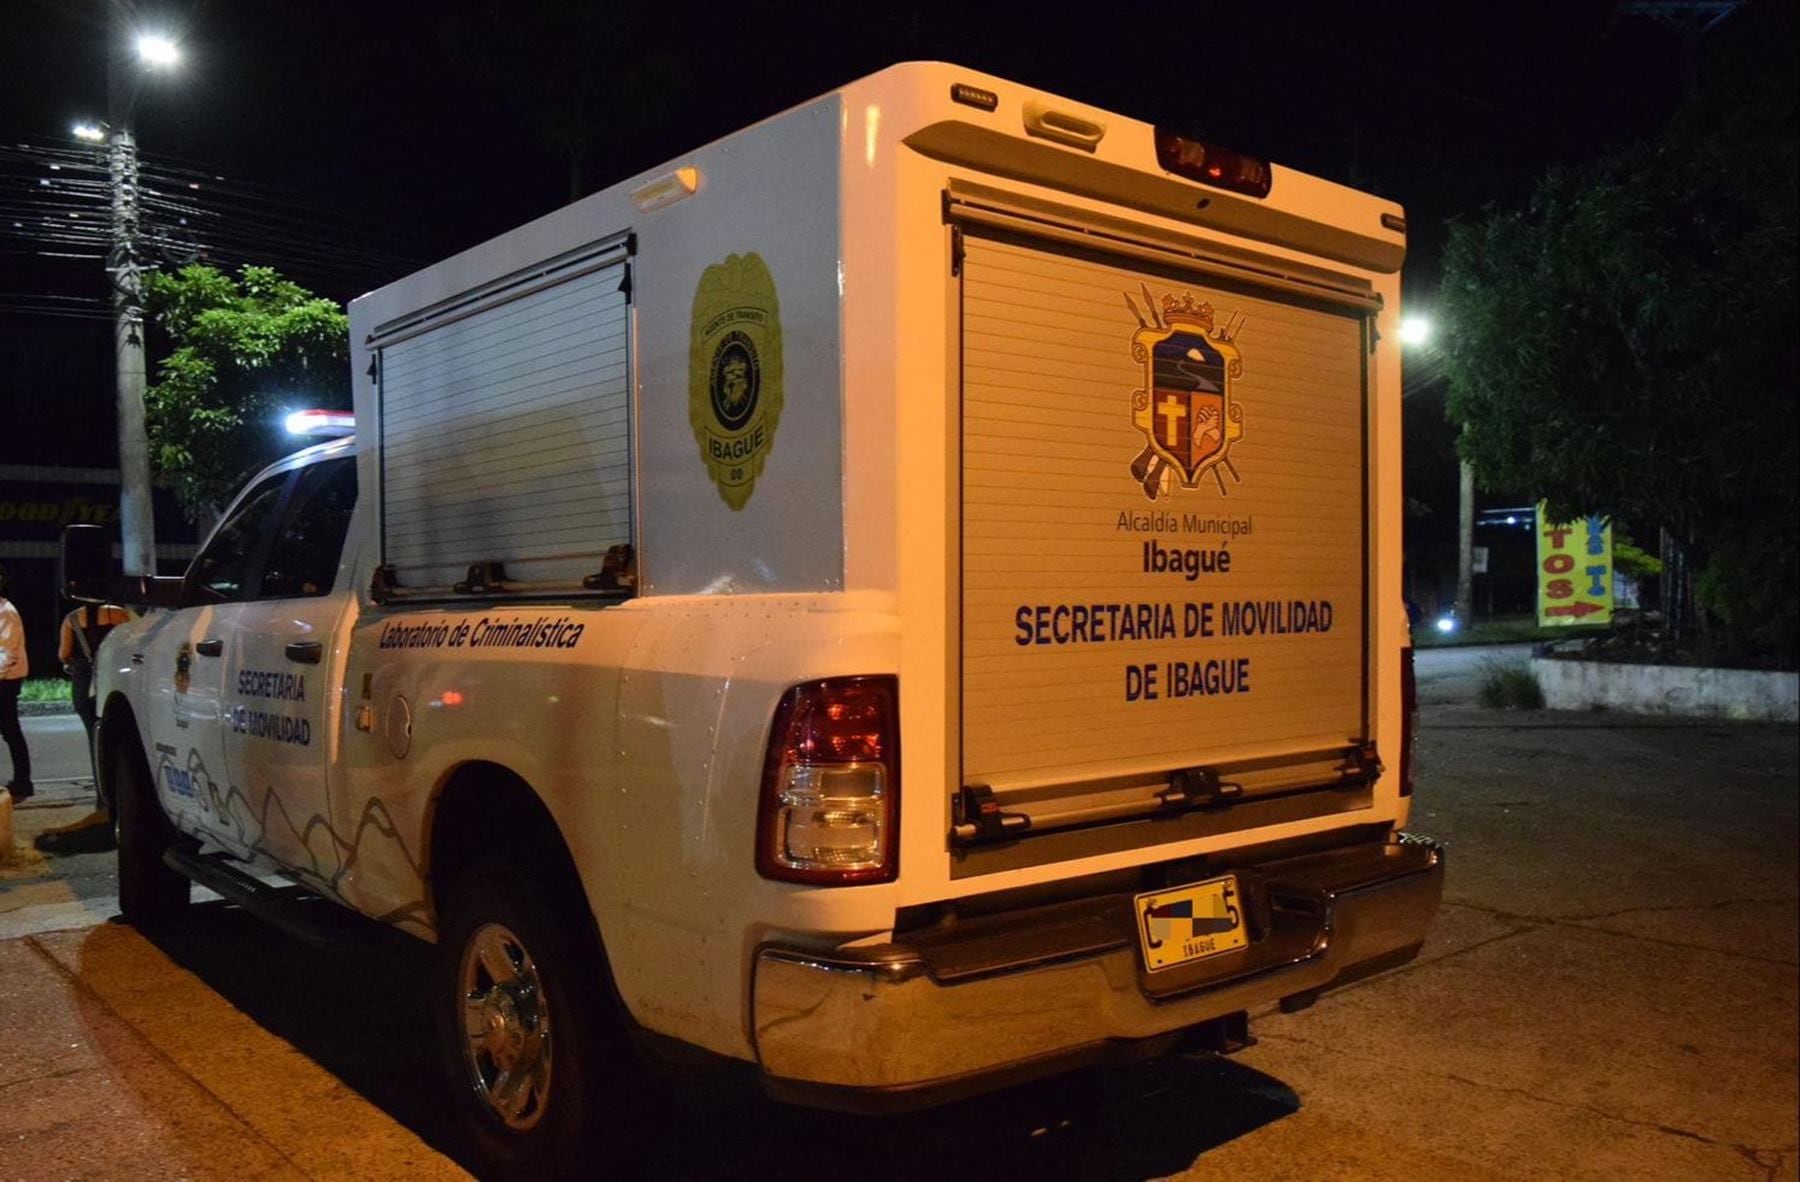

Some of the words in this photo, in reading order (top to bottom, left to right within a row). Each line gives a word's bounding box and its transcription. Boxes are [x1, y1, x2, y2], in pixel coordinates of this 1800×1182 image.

[708, 425, 764, 459] IBAGUE
[1116, 511, 1178, 533] Alcaldía
[1182, 513, 1252, 539] Municipal
[1143, 539, 1231, 581] Ibagué
[379, 619, 449, 649] Laboratorio
[448, 618, 470, 647] de
[469, 616, 585, 648] Criminalística
[1015, 603, 1176, 646] SECRETARIA
[1184, 602, 1214, 638] DE
[1222, 600, 1333, 636] MOVILIDAD
[238, 669, 306, 702] SECRETARIA
[1125, 663, 1159, 702] DE
[1166, 658, 1250, 698] IBAGUE
[232, 708, 247, 734] DE
[248, 710, 311, 746] MOVILIDAD
